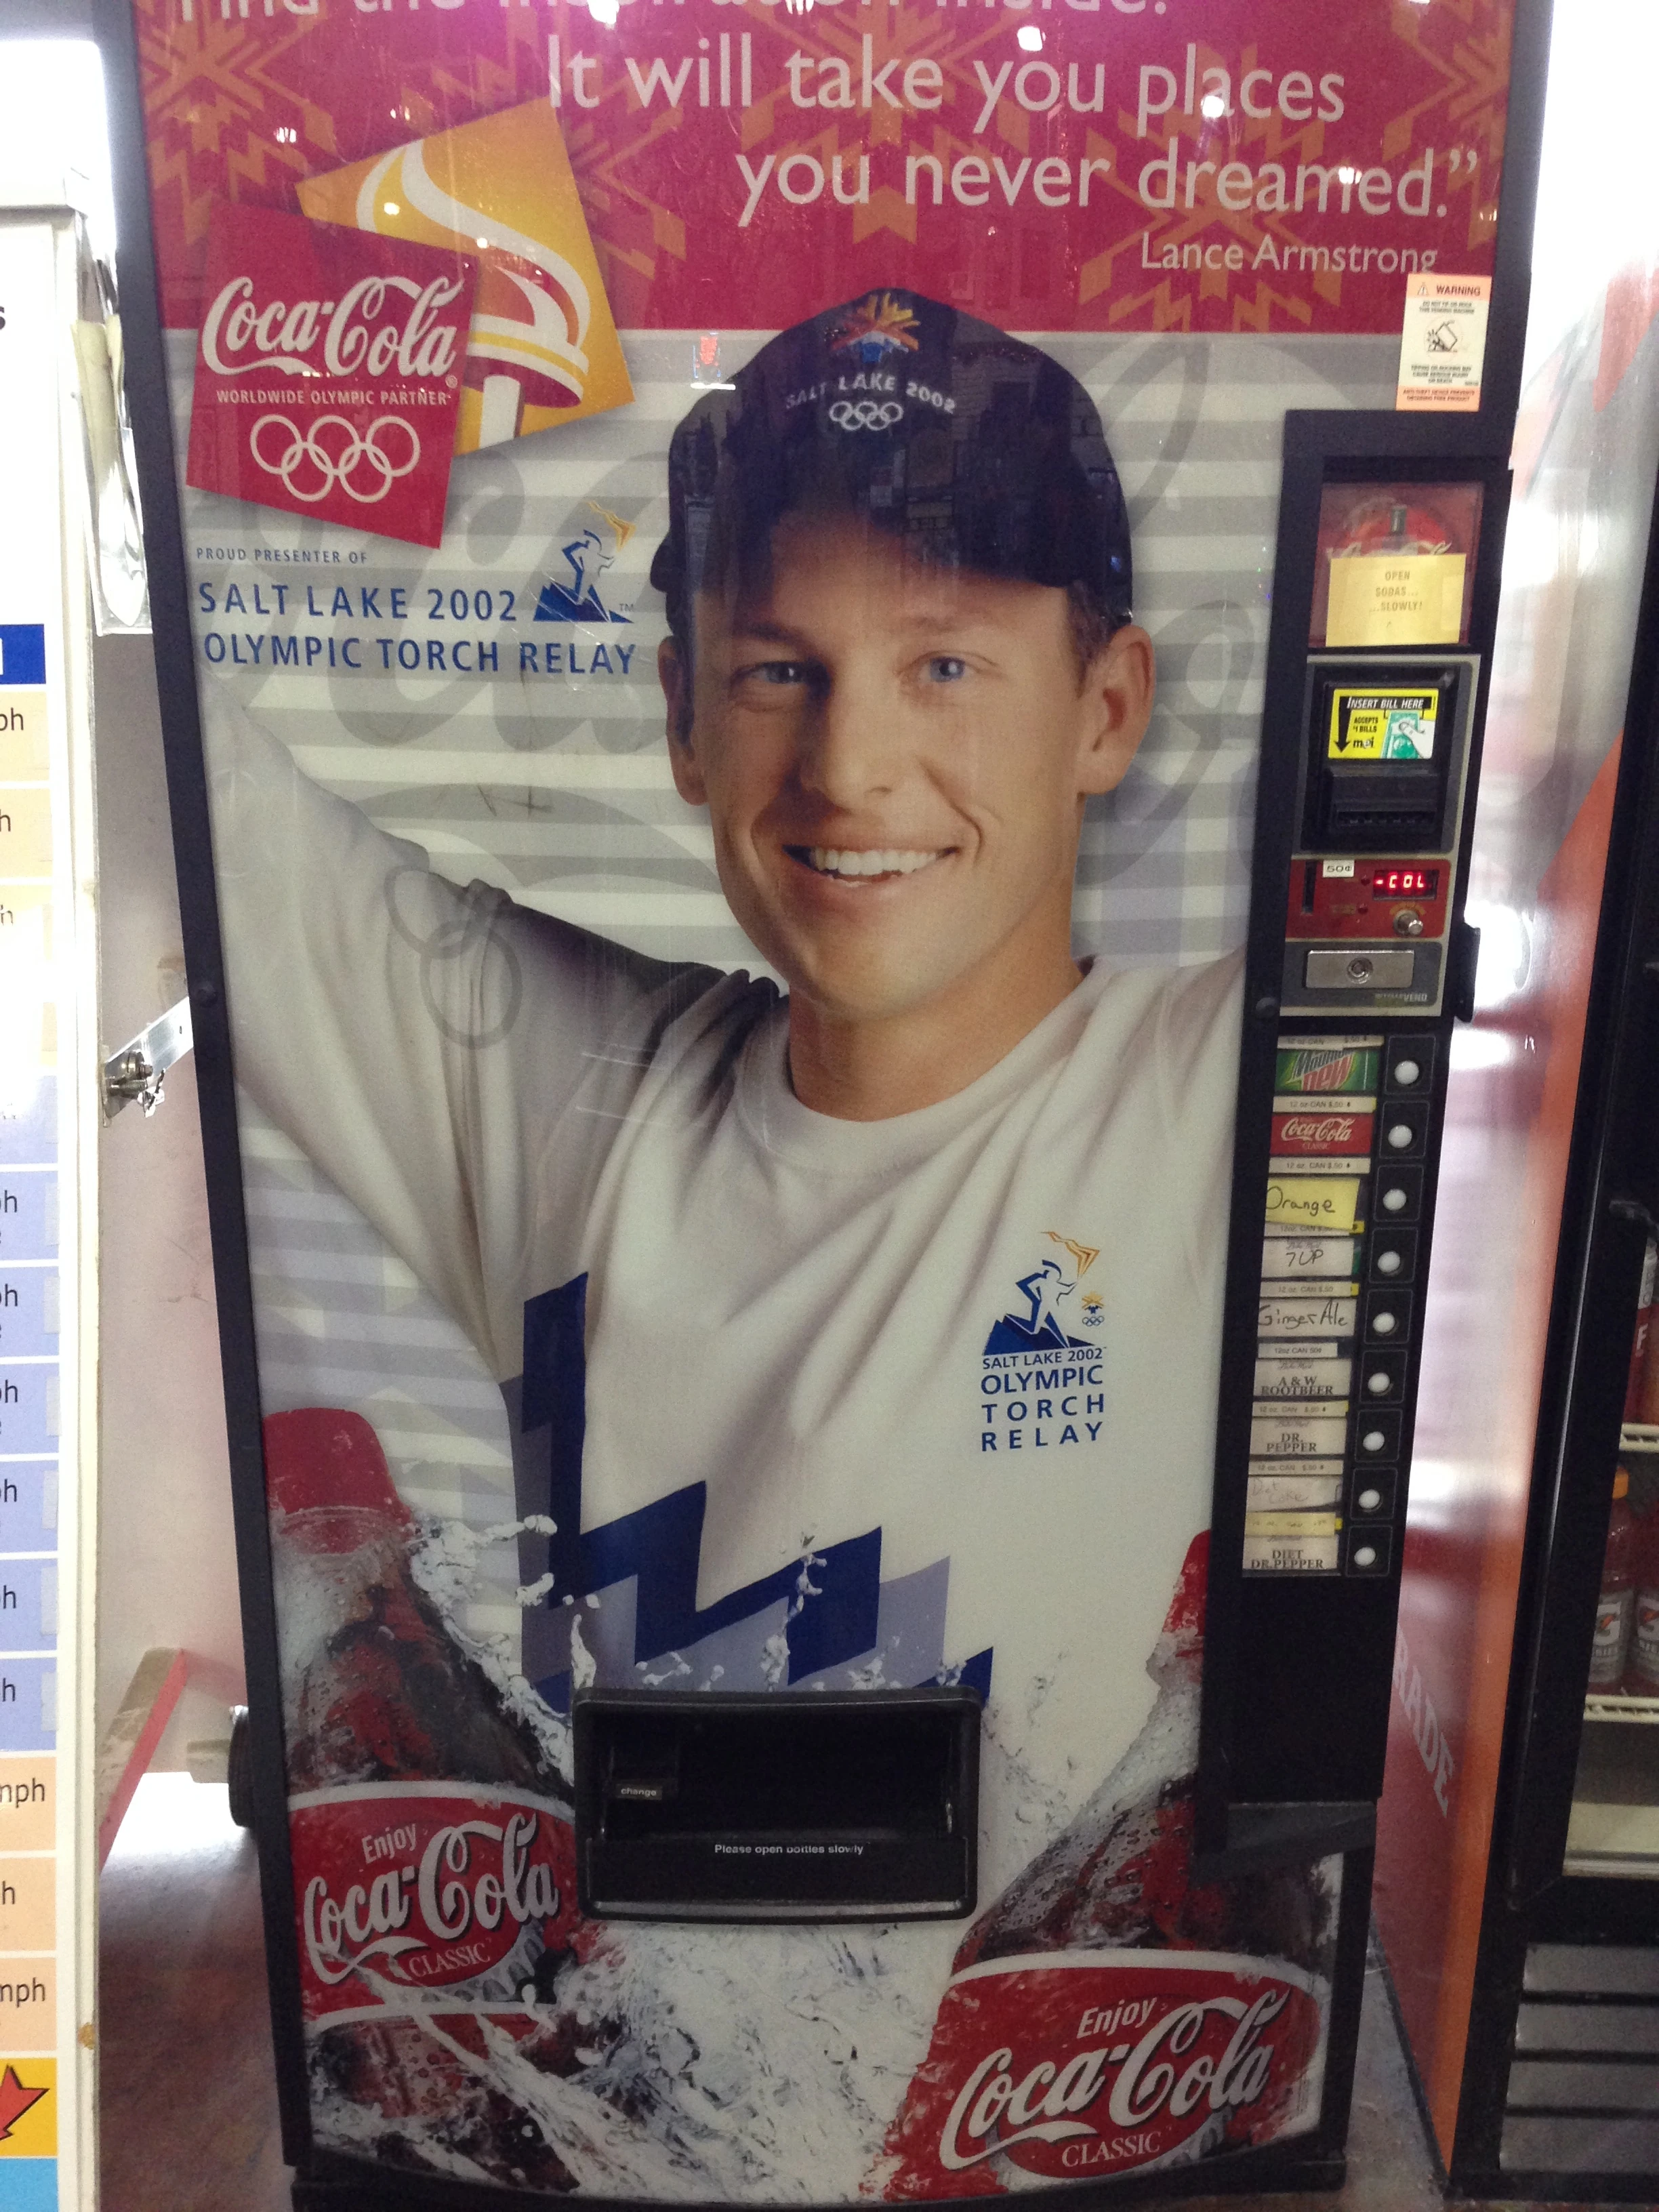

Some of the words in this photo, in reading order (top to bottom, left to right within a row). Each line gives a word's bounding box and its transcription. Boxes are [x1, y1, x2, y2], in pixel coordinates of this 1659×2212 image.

[548, 33, 600, 108] It
[625, 32, 752, 108] will
[784, 33, 944, 109] take
[972, 59, 1106, 134] you
[1138, 42, 1345, 138] places
[735, 153, 870, 228] you
[905, 154, 1110, 207] never
[1140, 230, 1244, 271] Lance
[1251, 234, 1438, 273] Armstrong
[1436, 285, 1481, 297] WARNING
[202, 274, 466, 377] Coca-Cola
[838, 372, 897, 391] LAKE
[216, 388, 305, 405] WORLDWIDE
[310, 389, 376, 406] OLYMPIC
[380, 390, 449, 407] PARTNER
[196, 547, 247, 562] PROUD
[254, 548, 341, 564] PRESENTER
[348, 550, 368, 565] OF
[1385, 571, 1410, 581] OPEN
[199, 581, 290, 616] SALT
[307, 585, 409, 619] LAKE
[427, 588, 517, 622] 2002
[203, 632, 362, 670] OLYMPIC
[380, 638, 499, 672] TORCH
[519, 642, 637, 675] RELAY
[1347, 697, 1379, 709] INSERT
[1380, 698, 1398, 709] BILL
[1401, 699, 1424, 709] HERE
[1326, 863, 1353, 874] 50¢
[1280, 1117, 1355, 1142] Coca-Cola
[1265, 1185, 1336, 1216] Orange
[1258, 1304, 1317, 1330] Ginger
[1319, 1298, 1347, 1326] Ale
[982, 1355, 1019, 1370] SALT
[1023, 1351, 1063, 1367] LAKE
[1067, 1347, 1103, 1363] 2002
[980, 1364, 1104, 1395] OLYMPIC
[1261, 1385, 1334, 1396] ROOTBEER
[1279, 1376, 1287, 1386] A
[1291, 1376, 1300, 1386] &
[1304, 1376, 1317, 1386] W
[981, 1393, 1105, 1424] TORCH
[981, 1421, 1103, 1452] RELAY
[1266, 1442, 1317, 1452] PEPPER
[1281, 1432, 1303, 1443] DR.
[1271, 1549, 1304, 1559] DIET
[620, 1786, 657, 1798] change
[361, 1822, 419, 1866] Enjoy
[714, 1844, 752, 1854] Please
[754, 1845, 783, 1856] open
[827, 1844, 865, 1856] slowly
[302, 1811, 560, 1986] Coca-Cola
[408, 1942, 492, 1980] CLASSIC
[1076, 1996, 1158, 2040] Enjoy
[939, 1987, 1292, 2171] Coca-Cola
[1061, 2130, 1162, 2169] CLASSIC
